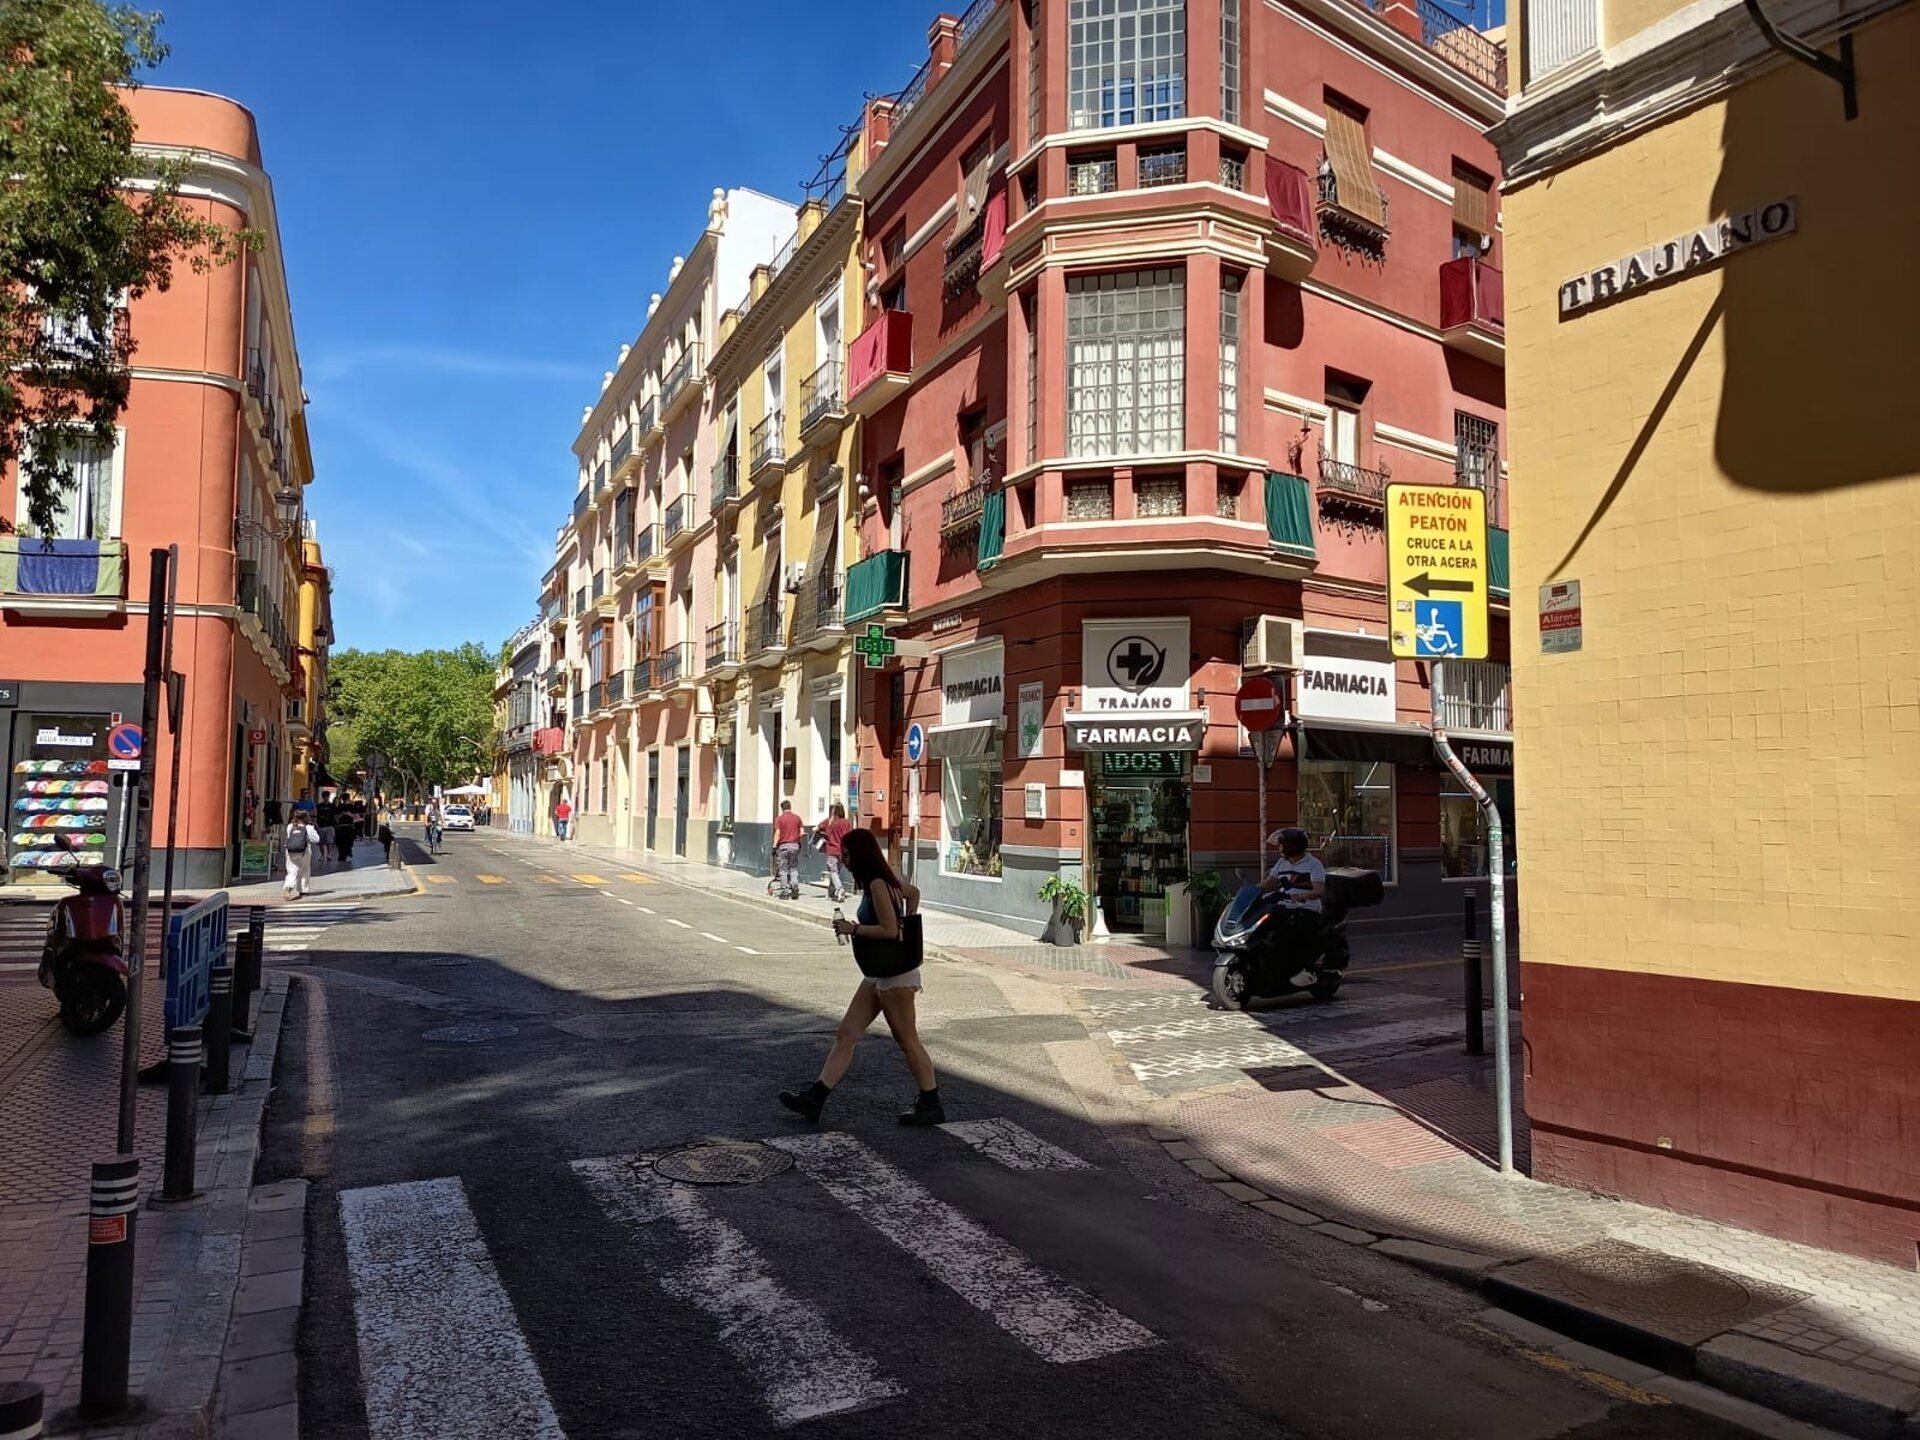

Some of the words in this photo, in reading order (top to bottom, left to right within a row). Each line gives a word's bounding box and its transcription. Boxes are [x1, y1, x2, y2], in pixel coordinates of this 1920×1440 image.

[1561, 203, 1789, 308] TRAJANO
[1399, 491, 1472, 510] ATENCIÓN
[1409, 513, 1467, 532] PEATÓN
[1406, 537, 1446, 550] CRUCE
[1449, 540, 1457, 550] A
[1459, 540, 1473, 551] LA
[1406, 555, 1437, 567] OTRA
[1439, 557, 1478, 569] ACERA
[946, 676, 1001, 704] FARMACIA
[1303, 669, 1388, 697] FARMACIA
[1098, 697, 1172, 709] TRAJANO
[1076, 727, 1192, 744] FARMACIA
[1463, 747, 1513, 766] FARMA
